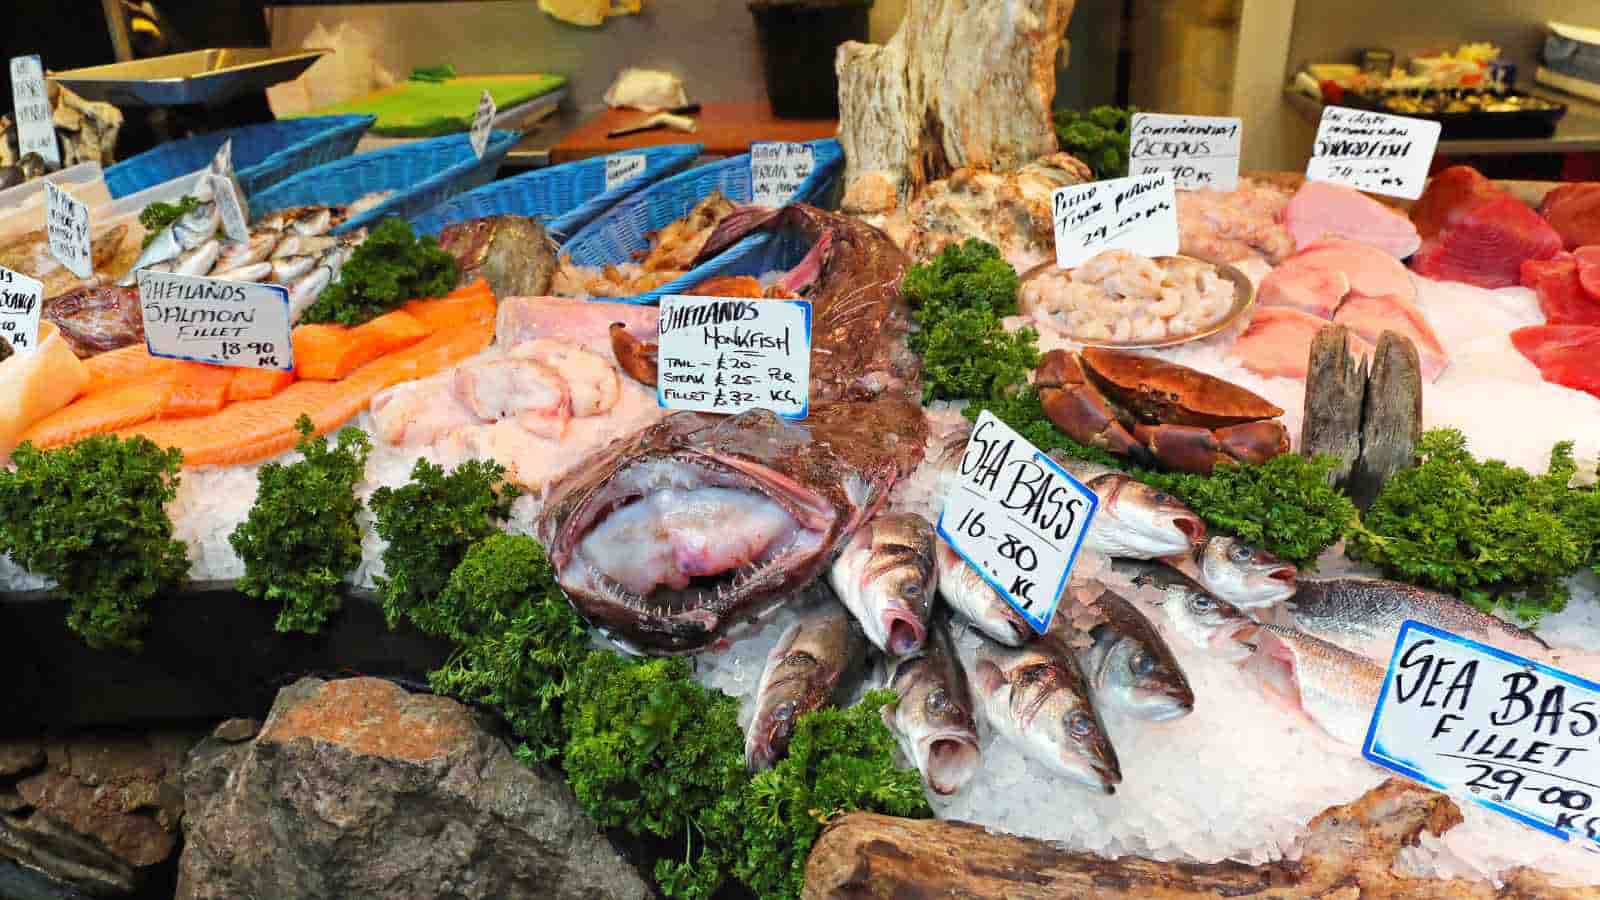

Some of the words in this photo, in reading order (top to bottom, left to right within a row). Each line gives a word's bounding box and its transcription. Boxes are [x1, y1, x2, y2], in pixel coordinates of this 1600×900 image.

[1131, 138, 1211, 158] OCTOPUS
[144, 302, 256, 324] SALMON
[177, 326, 249, 339] FILLET
[704, 325, 790, 357] MONKFISH
[663, 357, 697, 369] TAIL
[663, 371, 705, 385] STEAK
[664, 388, 713, 401] FILLET
[960, 420, 1016, 493] SEA
[999, 459, 1083, 541] BASS
[1395, 638, 1480, 711] SEA
[1489, 670, 1600, 737] BAS
[1430, 713, 1590, 768] FILLET
